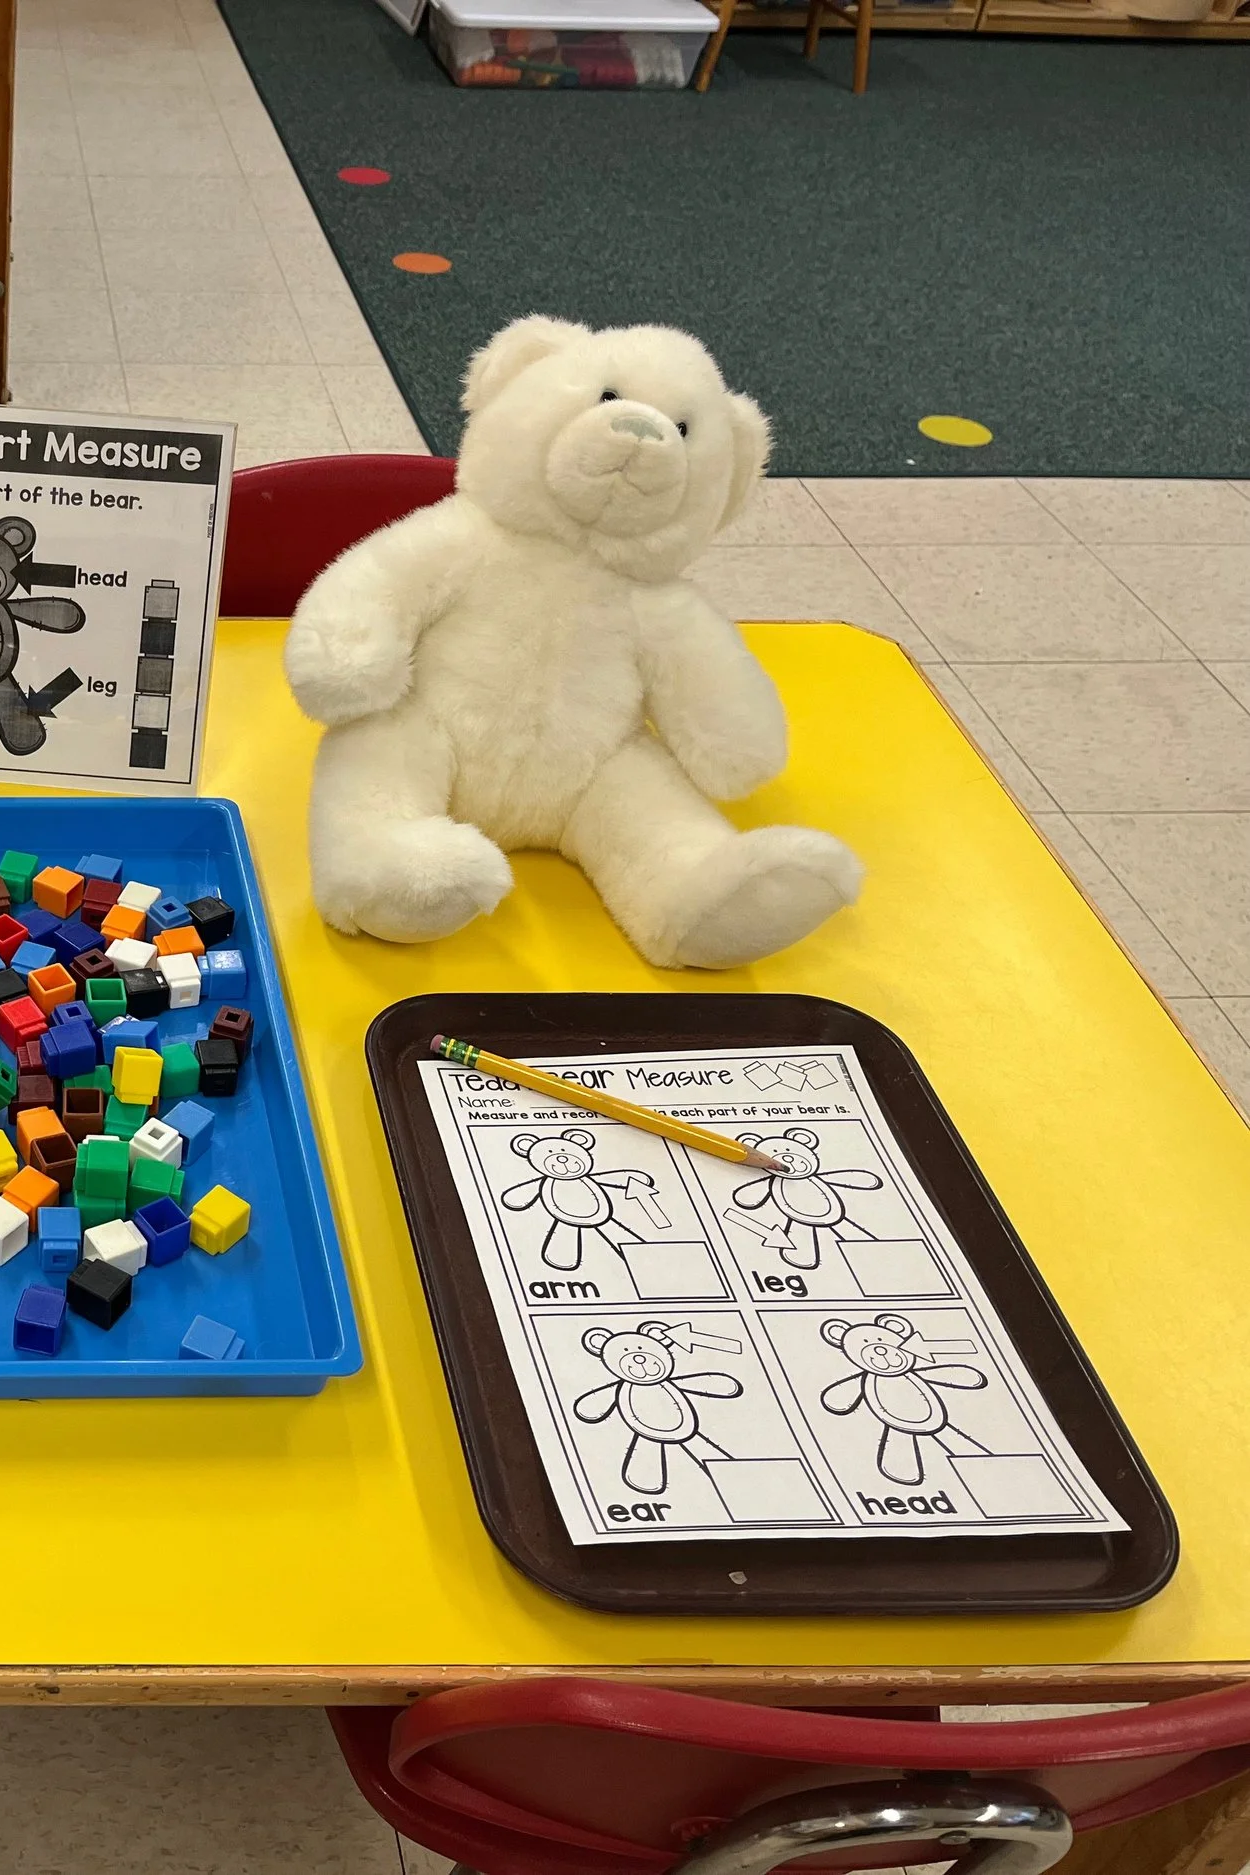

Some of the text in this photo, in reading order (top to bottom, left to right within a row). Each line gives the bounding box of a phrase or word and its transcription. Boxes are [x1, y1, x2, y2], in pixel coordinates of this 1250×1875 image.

[44, 432, 201, 470] Measure
[20, 486, 42, 503] of
[50, 487, 82, 505] the
[91, 490, 142, 509] bear.
[78, 568, 127, 587] head
[88, 676, 117, 697] leg
[449, 1074, 533, 1092] Tedd
[625, 1067, 734, 1090] Measure
[458, 1096, 515, 1108] Name:
[671, 1109, 706, 1117] each
[709, 1108, 739, 1117] part
[743, 1107, 757, 1115] of
[762, 1107, 793, 1117] your
[800, 1105, 830, 1114] bear
[836, 1105, 850, 1113] is.
[469, 1112, 528, 1120] Measure
[533, 1109, 558, 1119] and
[529, 1282, 600, 1298] arm
[752, 1271, 808, 1297] leg
[608, 1503, 671, 1522] ear
[861, 1492, 957, 1516] head
